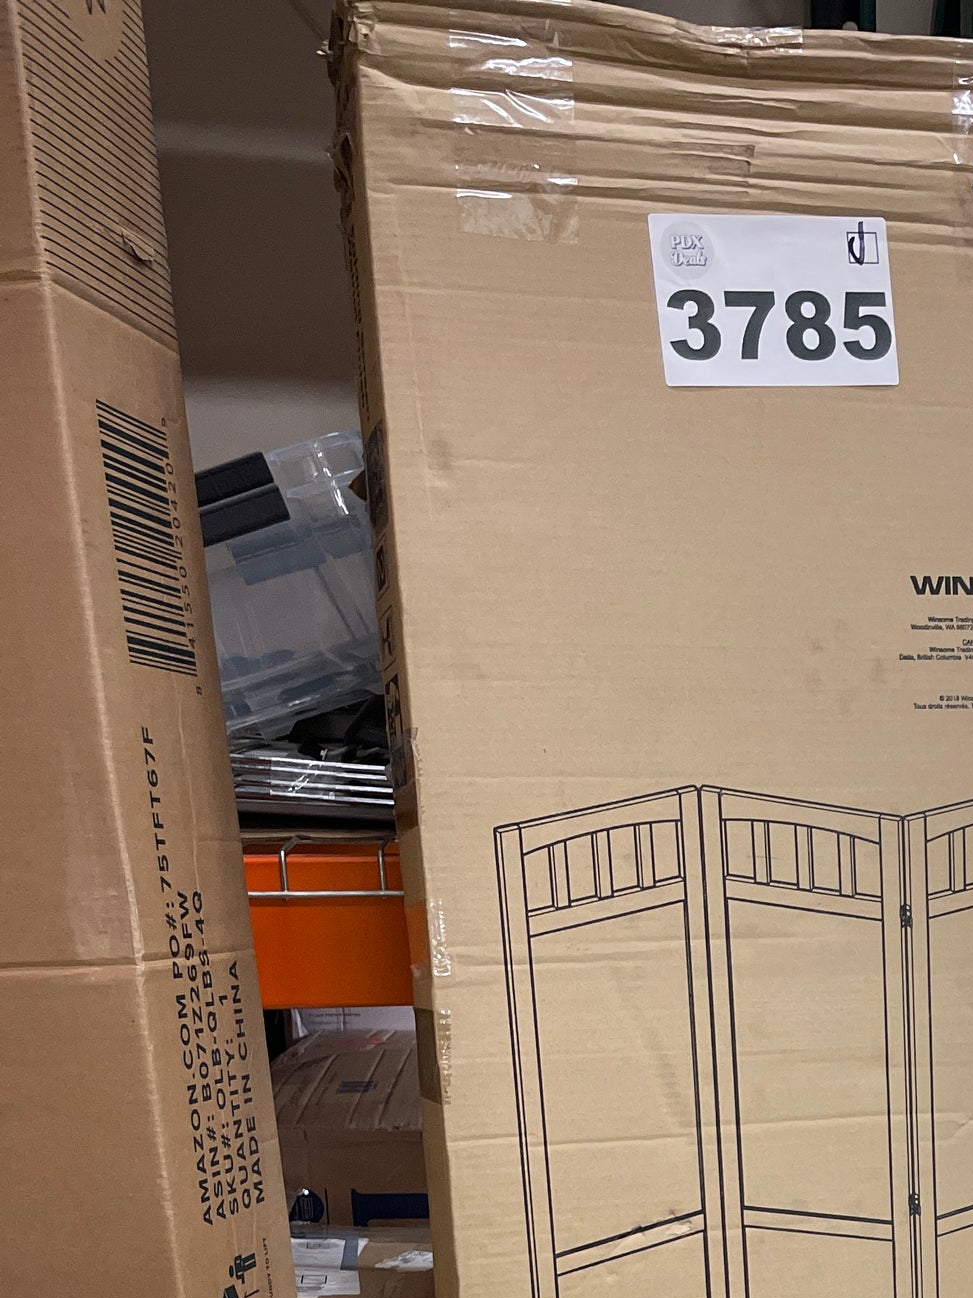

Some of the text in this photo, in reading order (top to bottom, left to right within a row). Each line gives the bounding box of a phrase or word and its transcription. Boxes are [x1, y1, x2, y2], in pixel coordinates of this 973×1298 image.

[670, 233, 705, 251] PDX
[666, 288, 893, 362] 3785
[164, 462, 185, 549] 20420
[177, 565, 197, 650] 41550
[141, 725, 213, 1226] AMAZON.COM PO#: 75TFT67F
[177, 890, 227, 1220] ASIN#: B071Z269FW
[192, 890, 239, 1216] SKU#: OLB-QLBS-4Q
[217, 994, 252, 1210] QUANTITY: 1
[228, 959, 265, 1205] MADE IN CHINA
[264, 1257, 271, 1271] TO
